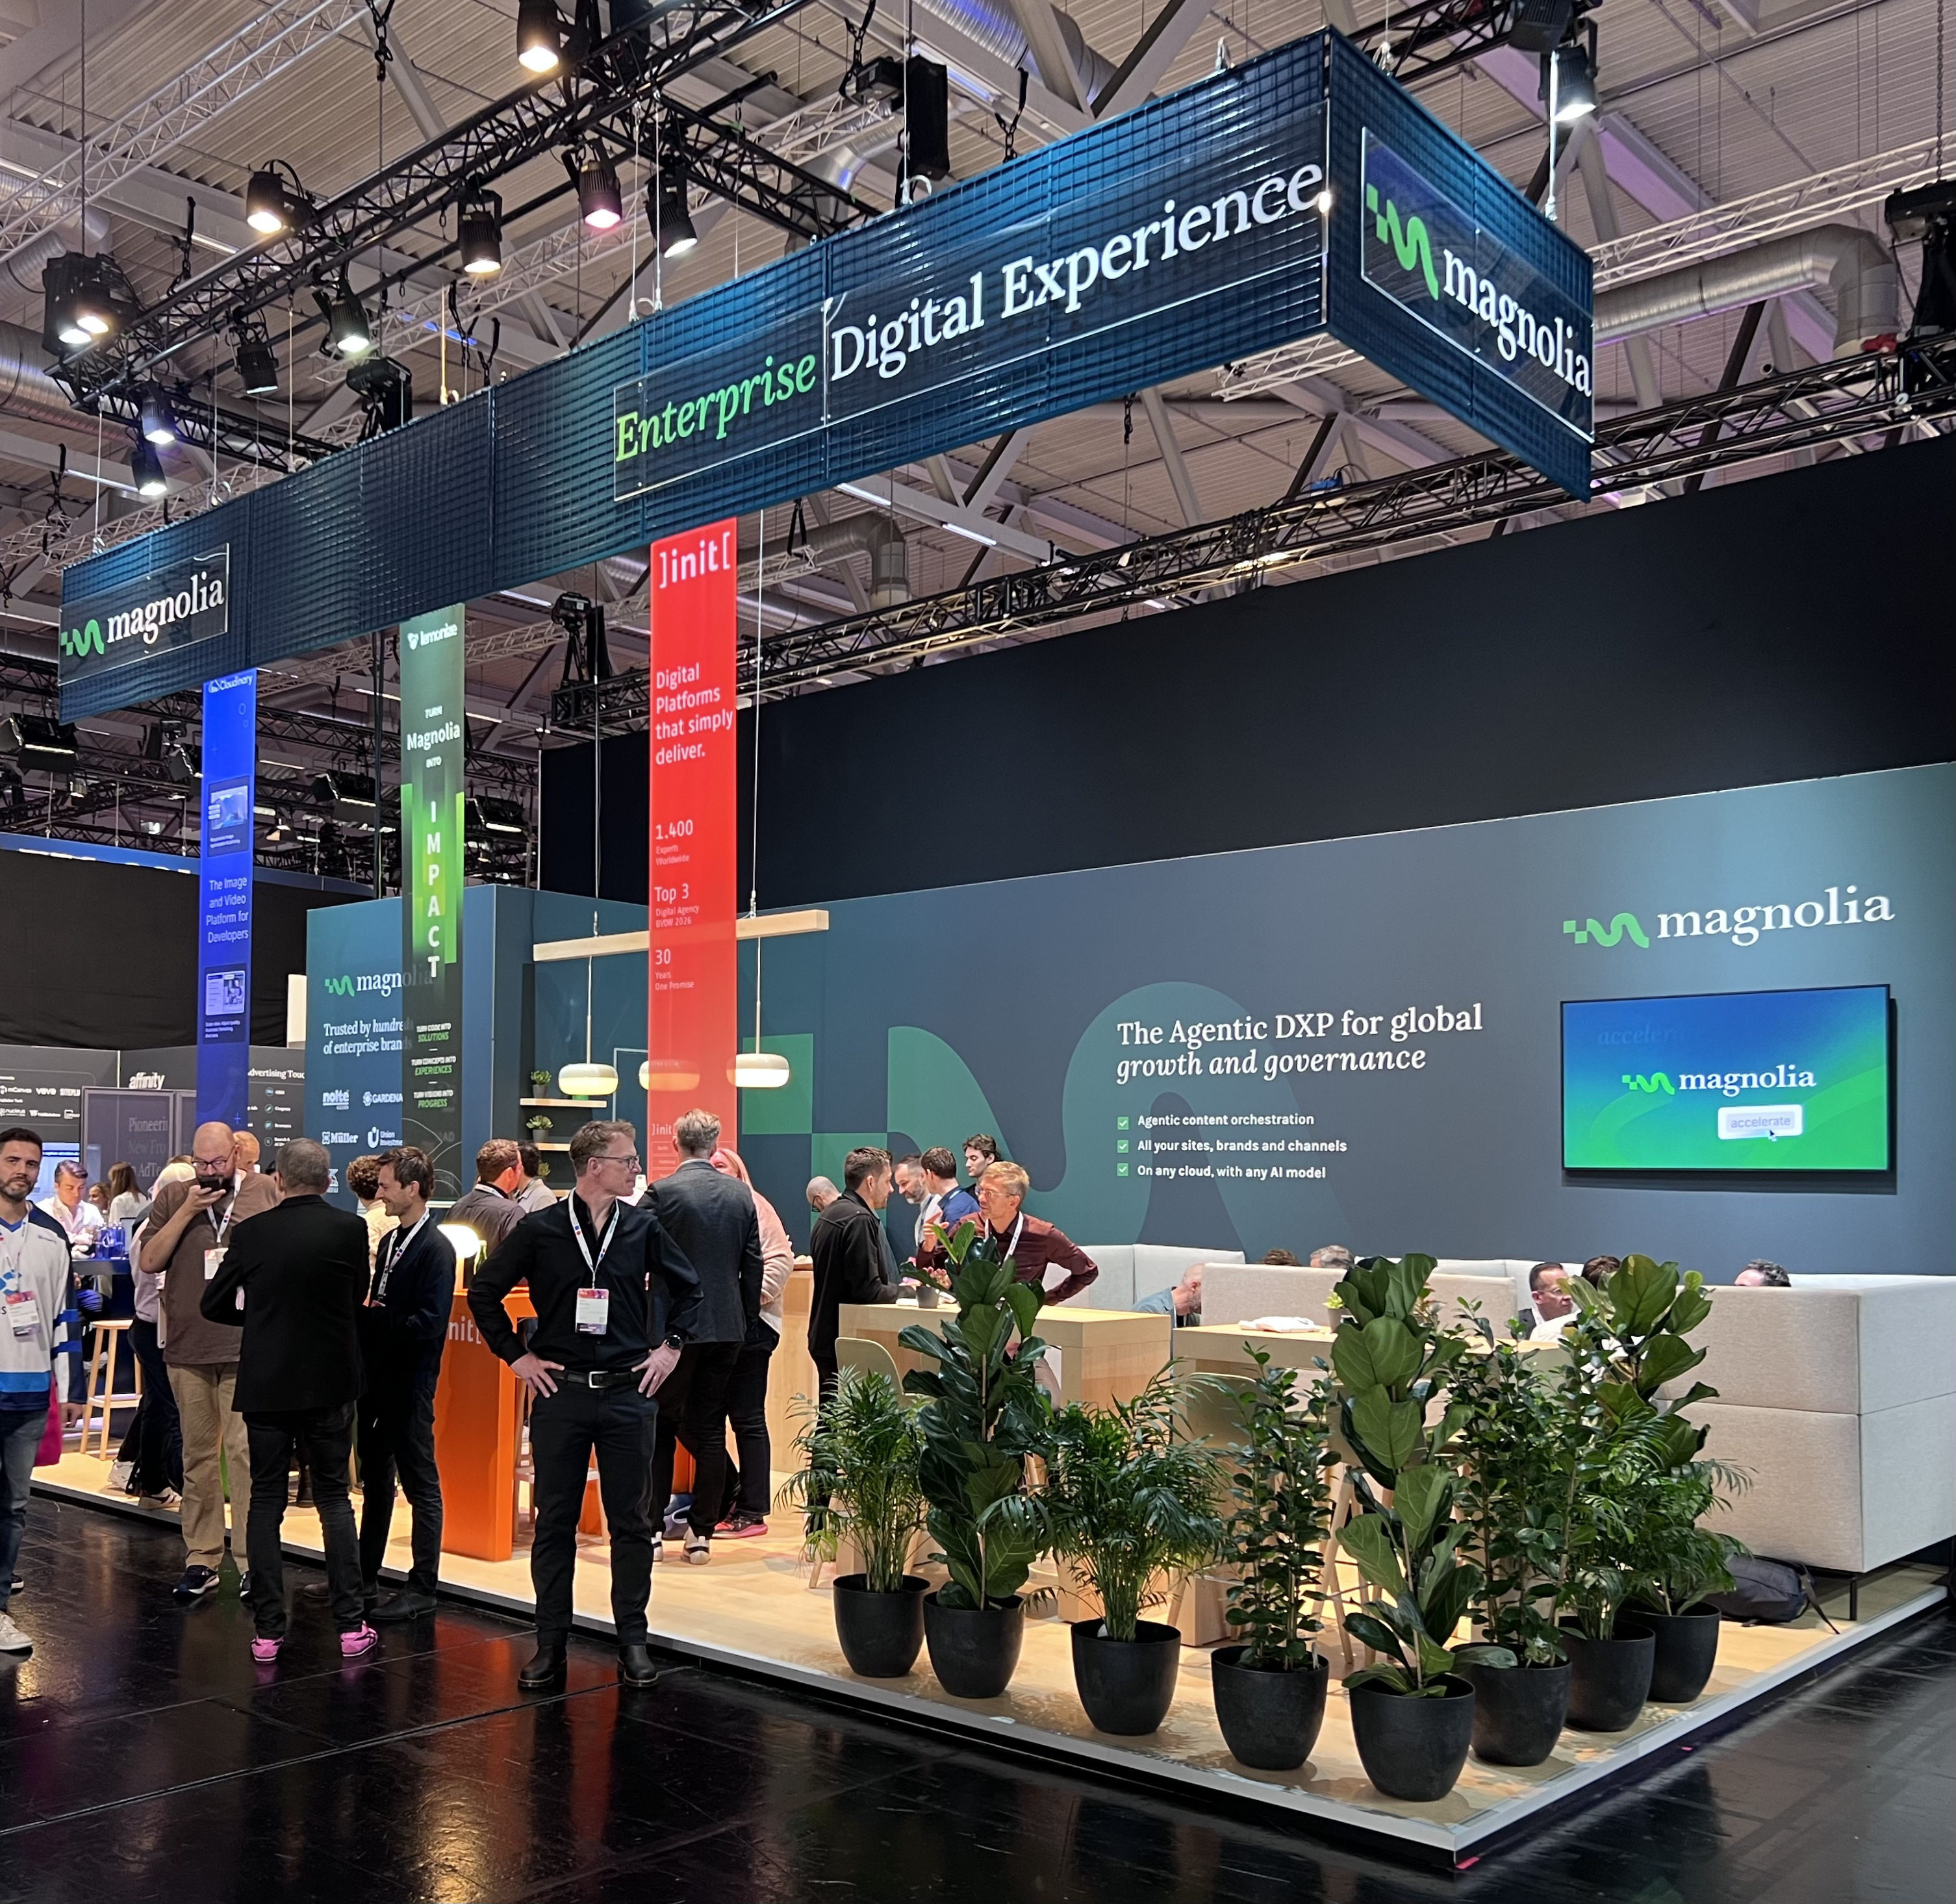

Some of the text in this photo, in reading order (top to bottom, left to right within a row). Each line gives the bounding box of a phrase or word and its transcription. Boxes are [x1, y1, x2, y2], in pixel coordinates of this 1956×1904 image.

[616, 163, 1323, 462] Enterprise Digital Experience
[1443, 248, 1592, 397] magnolia
[107, 572, 225, 644] magnolia
[420, 623, 458, 646] lemonize
[656, 663, 699, 691] Digital
[656, 687, 720, 714] Platforms
[425, 705, 443, 718] TURN
[655, 709, 733, 740] that simply
[407, 721, 461, 751] Magnolia
[655, 744, 705, 765] deliver.
[655, 819, 693, 840] 1.400
[656, 844, 679, 855] Experts
[656, 854, 690, 866] Worldwide
[209, 877, 248, 891] The Image
[427, 801, 440, 978] IMPACT
[209, 894, 246, 908] and Video
[654, 883, 689, 904] Top 3
[207, 910, 249, 926] Platform for
[656, 905, 700, 917] Digital Agency
[1657, 885, 1896, 946] magnolia
[675, 916, 692, 926] 2026
[208, 930, 249, 943] Developers
[655, 948, 671, 965] 30
[655, 971, 672, 980] Years
[655, 980, 694, 991] One Promise
[324, 1021, 358, 1037] Trusted
[360, 1019, 372, 1037] by
[1117, 1003, 1483, 1050] The Agentic DXP for global
[418, 1032, 449, 1043] SOLUTIONS
[323, 1041, 333, 1055] of
[335, 1039, 379, 1057] enterprise
[415, 1065, 452, 1076] EXPERIENCES
[1116, 1049, 1427, 1085] growth and governance
[129, 1072, 165, 1090] affinity
[1679, 1064, 1816, 1097] magnolia
[372, 1093, 403, 1103] GARDENA
[418, 1099, 448, 1109] PROGRESS
[1137, 1113, 1314, 1128] Agentic content orchestration
[1731, 1115, 1791, 1129] accelerate
[331, 1132, 359, 1143] Müller
[1137, 1140, 1347, 1154] All your sites, brands and channels
[1137, 1165, 1326, 1180] On any cloud, with any AI model
